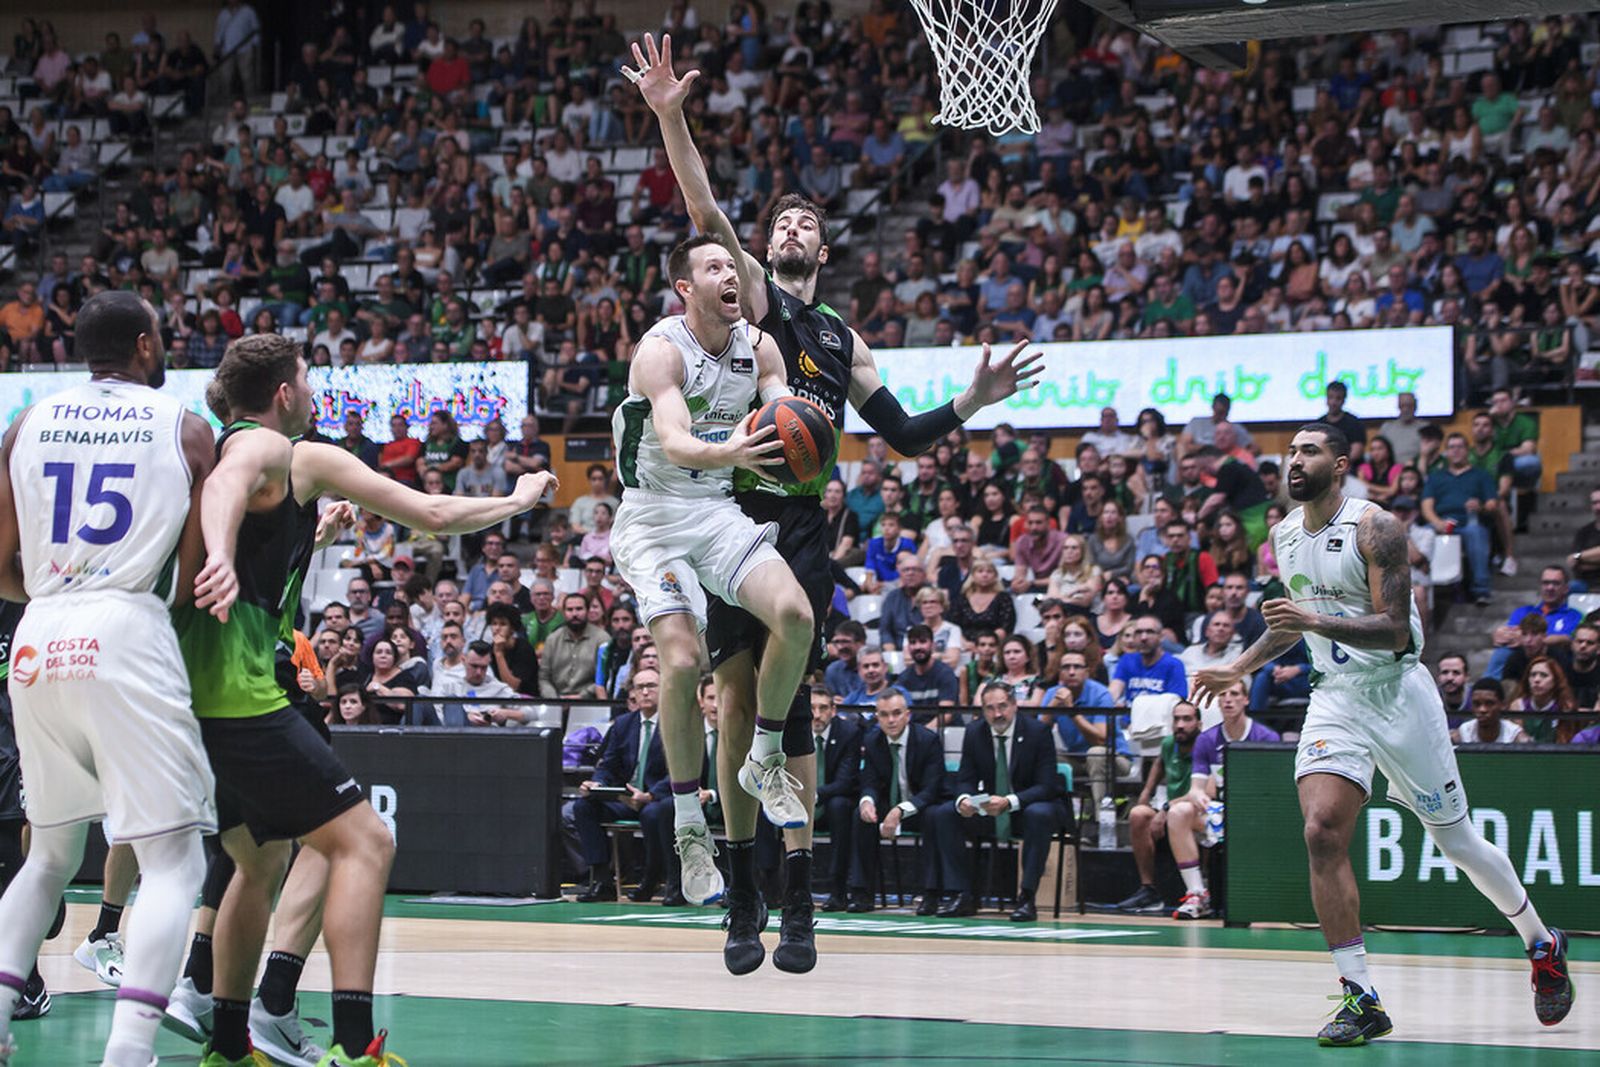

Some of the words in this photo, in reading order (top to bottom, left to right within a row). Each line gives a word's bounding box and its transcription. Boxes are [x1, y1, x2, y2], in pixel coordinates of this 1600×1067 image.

[52, 404, 154, 422] THOMAS
[39, 429, 153, 445] BENAHAVÍS
[43, 462, 136, 545] 15
[47, 638, 100, 654] COSTA
[46, 656, 66, 670] DEL
[69, 654, 98, 667] SOL
